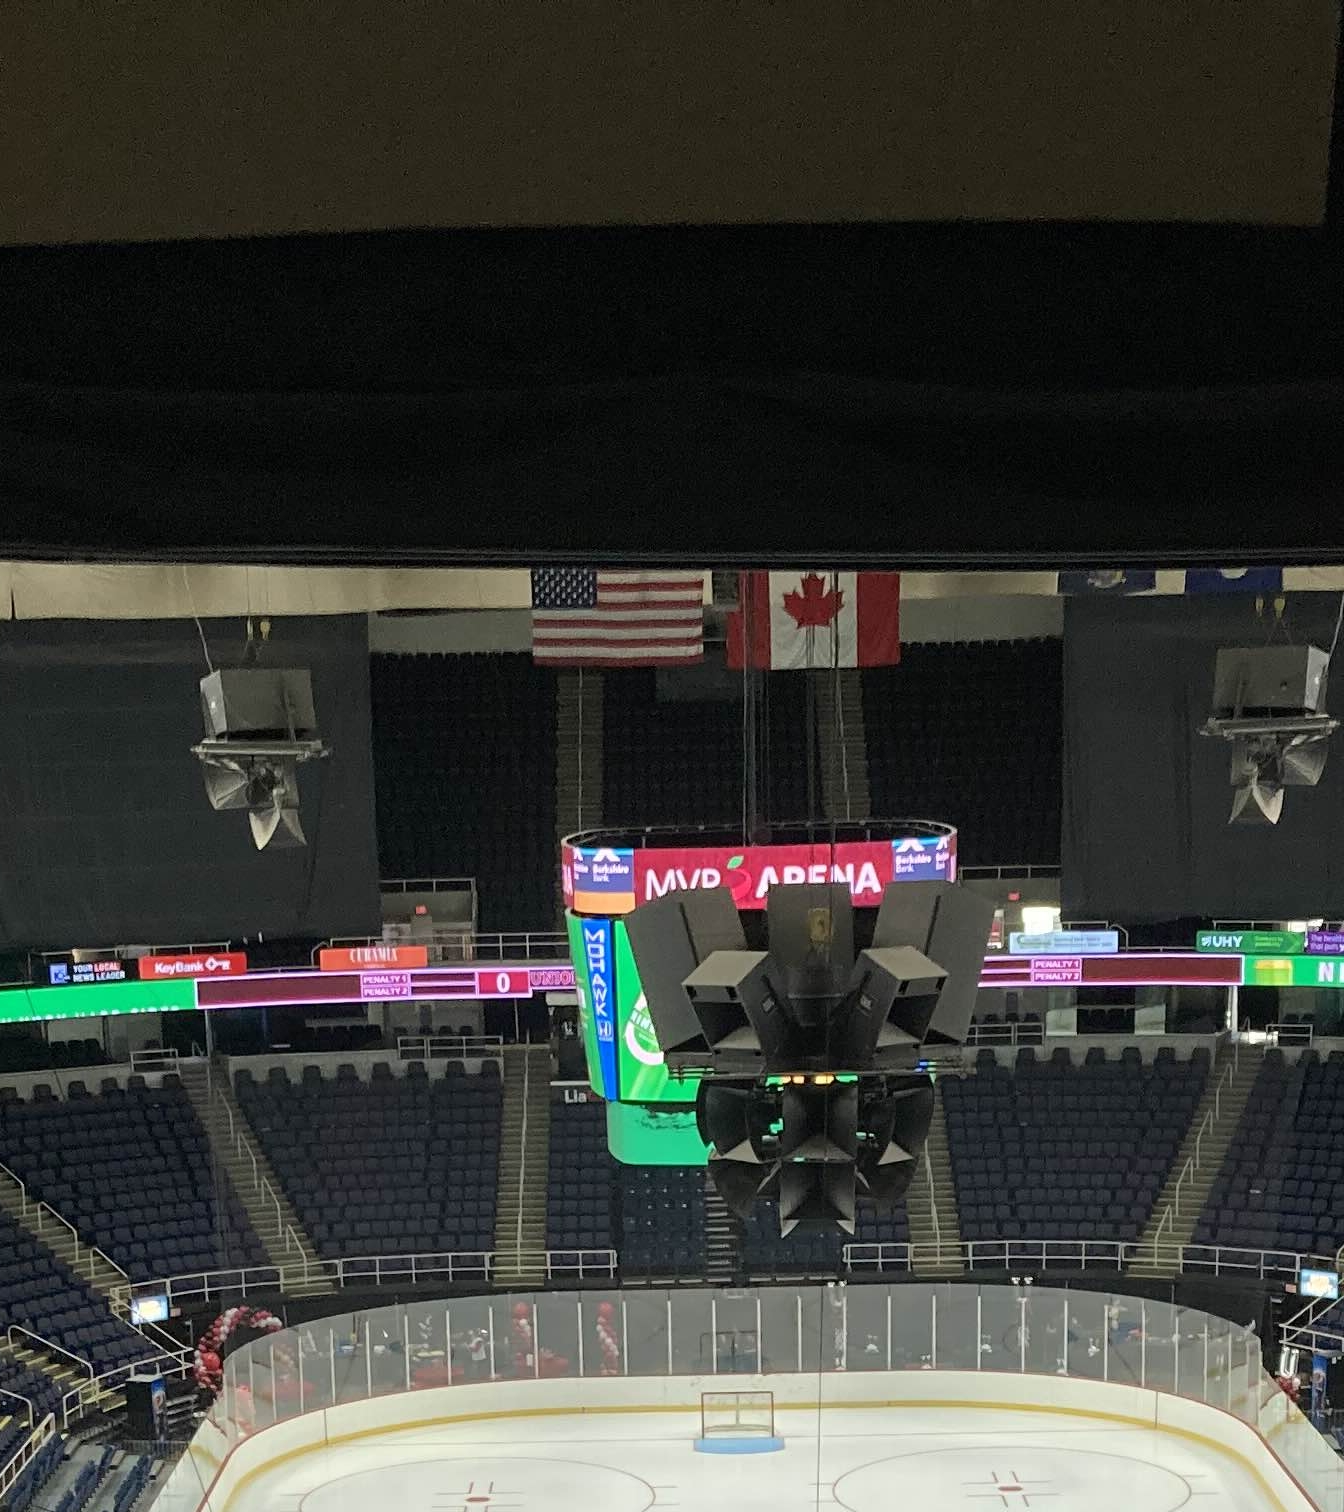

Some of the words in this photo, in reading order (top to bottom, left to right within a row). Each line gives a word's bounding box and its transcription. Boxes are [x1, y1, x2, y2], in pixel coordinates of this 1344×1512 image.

[646, 867, 721, 900] MVP
[1212, 936, 1243, 948] UHY
[73, 964, 93, 974] YOUR
[94, 962, 121, 972] LOCAL
[154, 960, 205, 975] KeyBank
[584, 928, 607, 1017] MOHAWK
[96, 970, 126, 980] LEADER
[364, 975, 400, 984] PENALTY
[1035, 972, 1073, 980] PENALTY
[496, 972, 510, 993] 0
[364, 987, 400, 996] PENALTY
